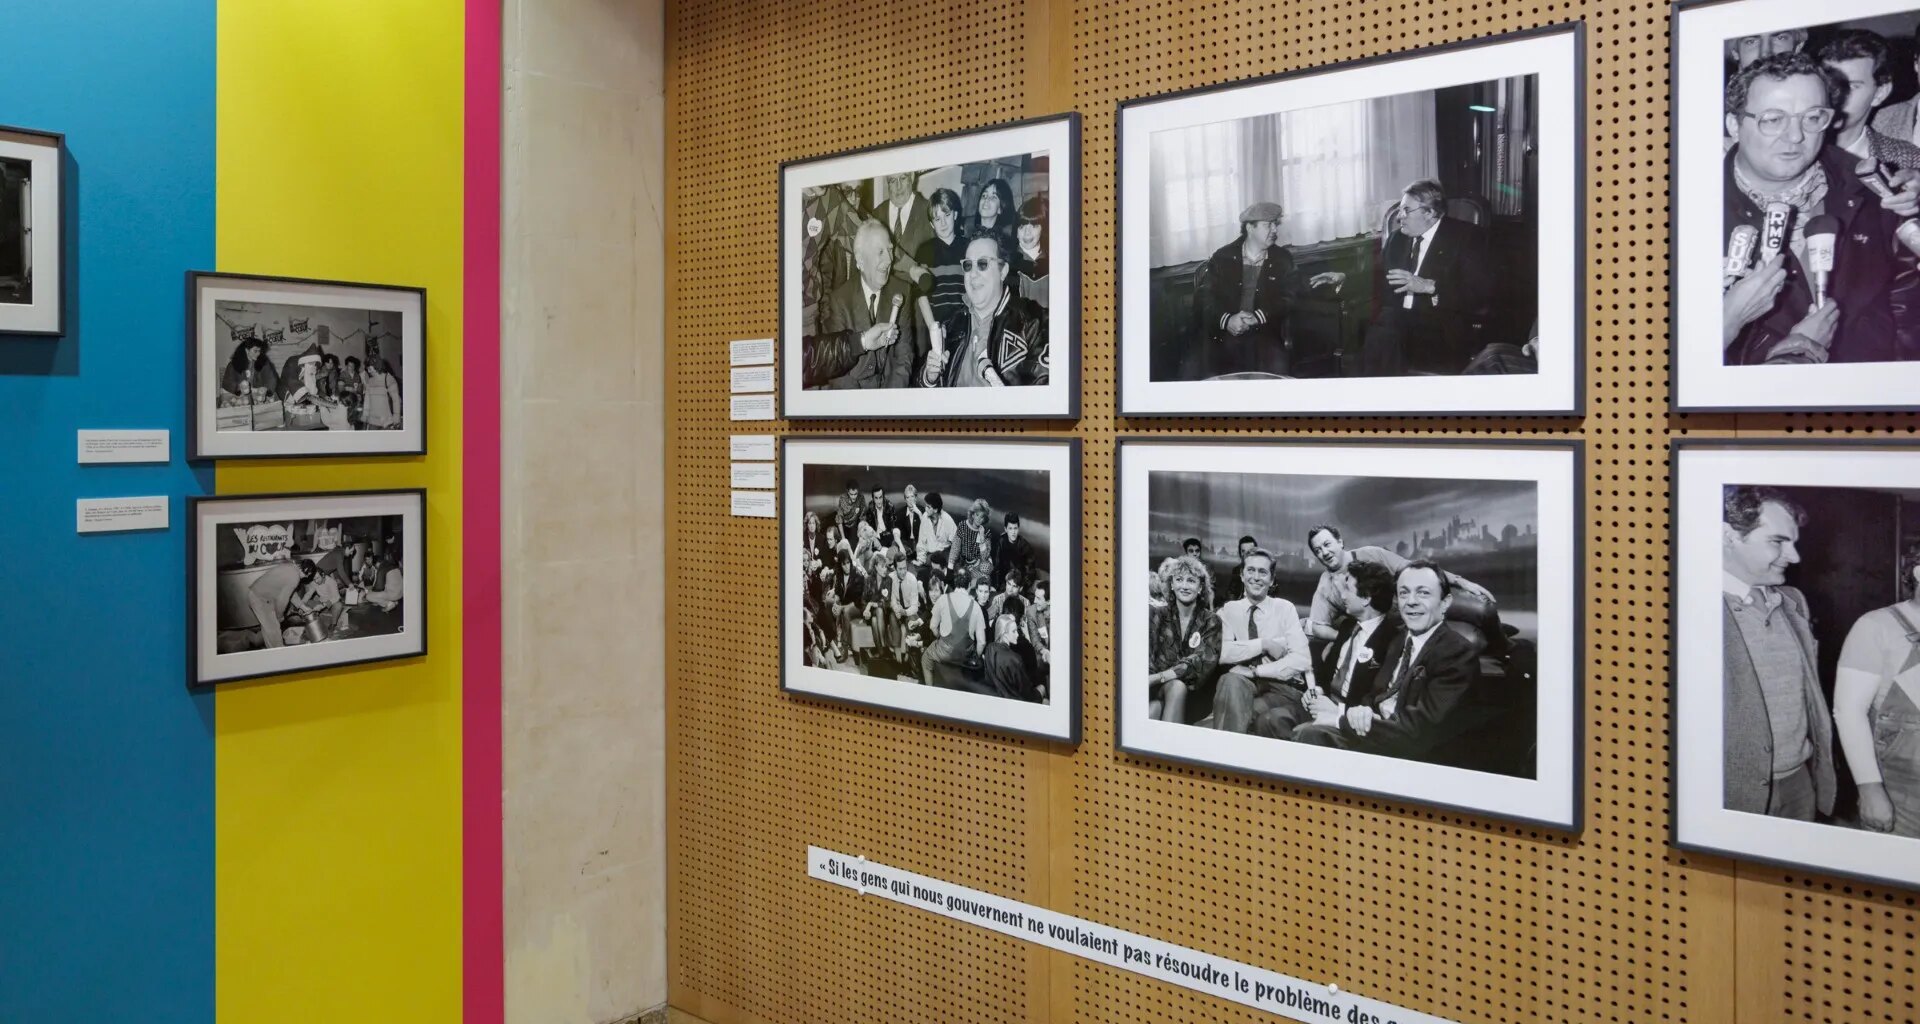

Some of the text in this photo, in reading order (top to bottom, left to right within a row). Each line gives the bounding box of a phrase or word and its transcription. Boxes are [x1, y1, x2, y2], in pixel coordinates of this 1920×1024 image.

[1769, 211, 1786, 248] RMC
[1728, 232, 1747, 273] SUD
[247, 534, 258, 544] LES
[249, 543, 259, 554] DU
[828, 859, 839, 877] Si
[841, 861, 858, 883] les
[860, 870, 888, 890] gens
[890, 879, 910, 897] qui
[913, 885, 944, 906] nous
[946, 895, 1024, 930] gouvernent
[1027, 917, 1045, 936] ne
[1048, 922, 1120, 958] voulaient
[1123, 943, 1152, 967] pas
[1155, 952, 1230, 988] résoudre
[1234, 971, 1250, 995] le
[1255, 981, 1341, 1020] problème
